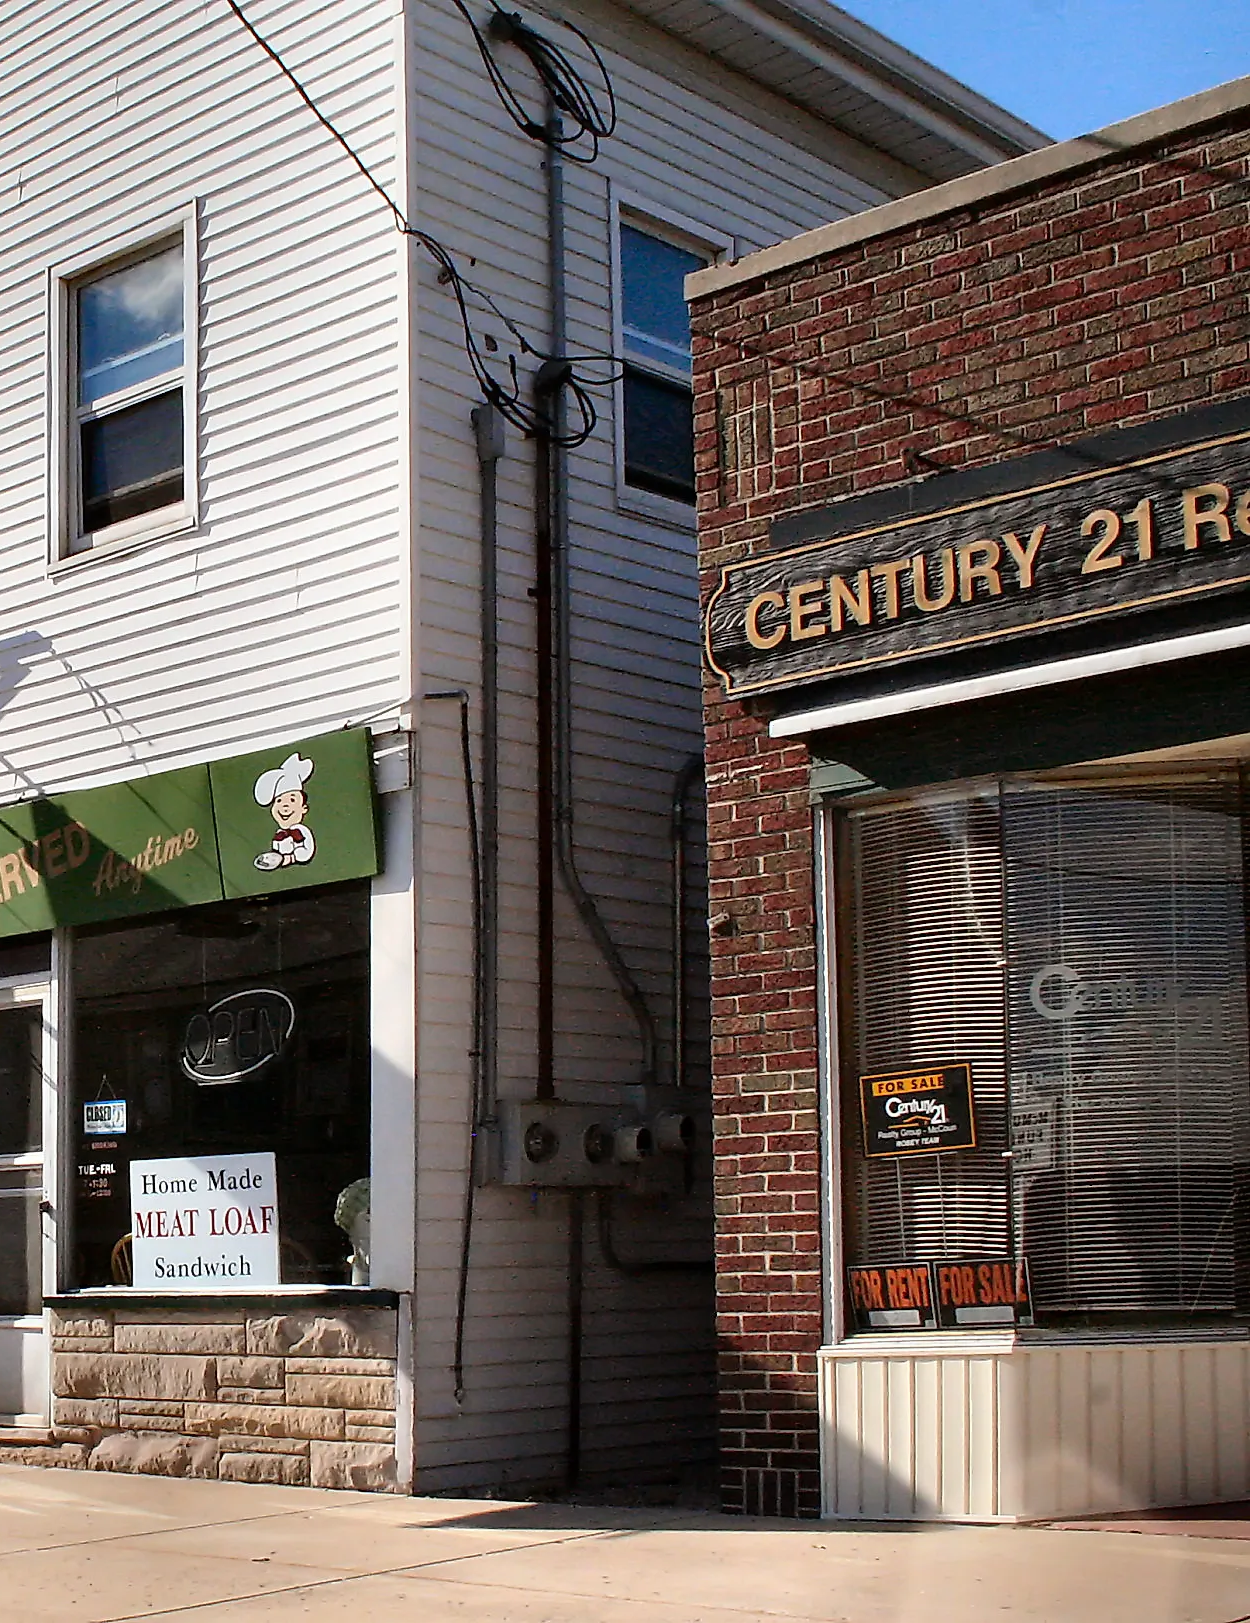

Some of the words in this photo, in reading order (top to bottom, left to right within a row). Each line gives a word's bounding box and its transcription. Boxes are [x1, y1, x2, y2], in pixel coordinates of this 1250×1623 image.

[745, 523, 1047, 650] CENTURY
[1080, 499, 1154, 575] 21
[92, 826, 200, 897] Anytime
[186, 1006, 284, 1065] OPEN
[877, 1081, 904, 1093] FOR
[911, 1076, 944, 1089] SALE
[885, 1097, 937, 1118] Century
[930, 1104, 946, 1124] 21
[141, 1174, 198, 1195] Home
[206, 1168, 263, 1191] Made
[135, 1209, 199, 1238] MEAT
[208, 1206, 274, 1236] LOAF
[154, 1254, 252, 1279] Sandwich
[939, 1265, 976, 1305] FOR
[977, 1261, 1028, 1304] SALE
[851, 1269, 885, 1310] FOR
[885, 1267, 930, 1308] RENT
